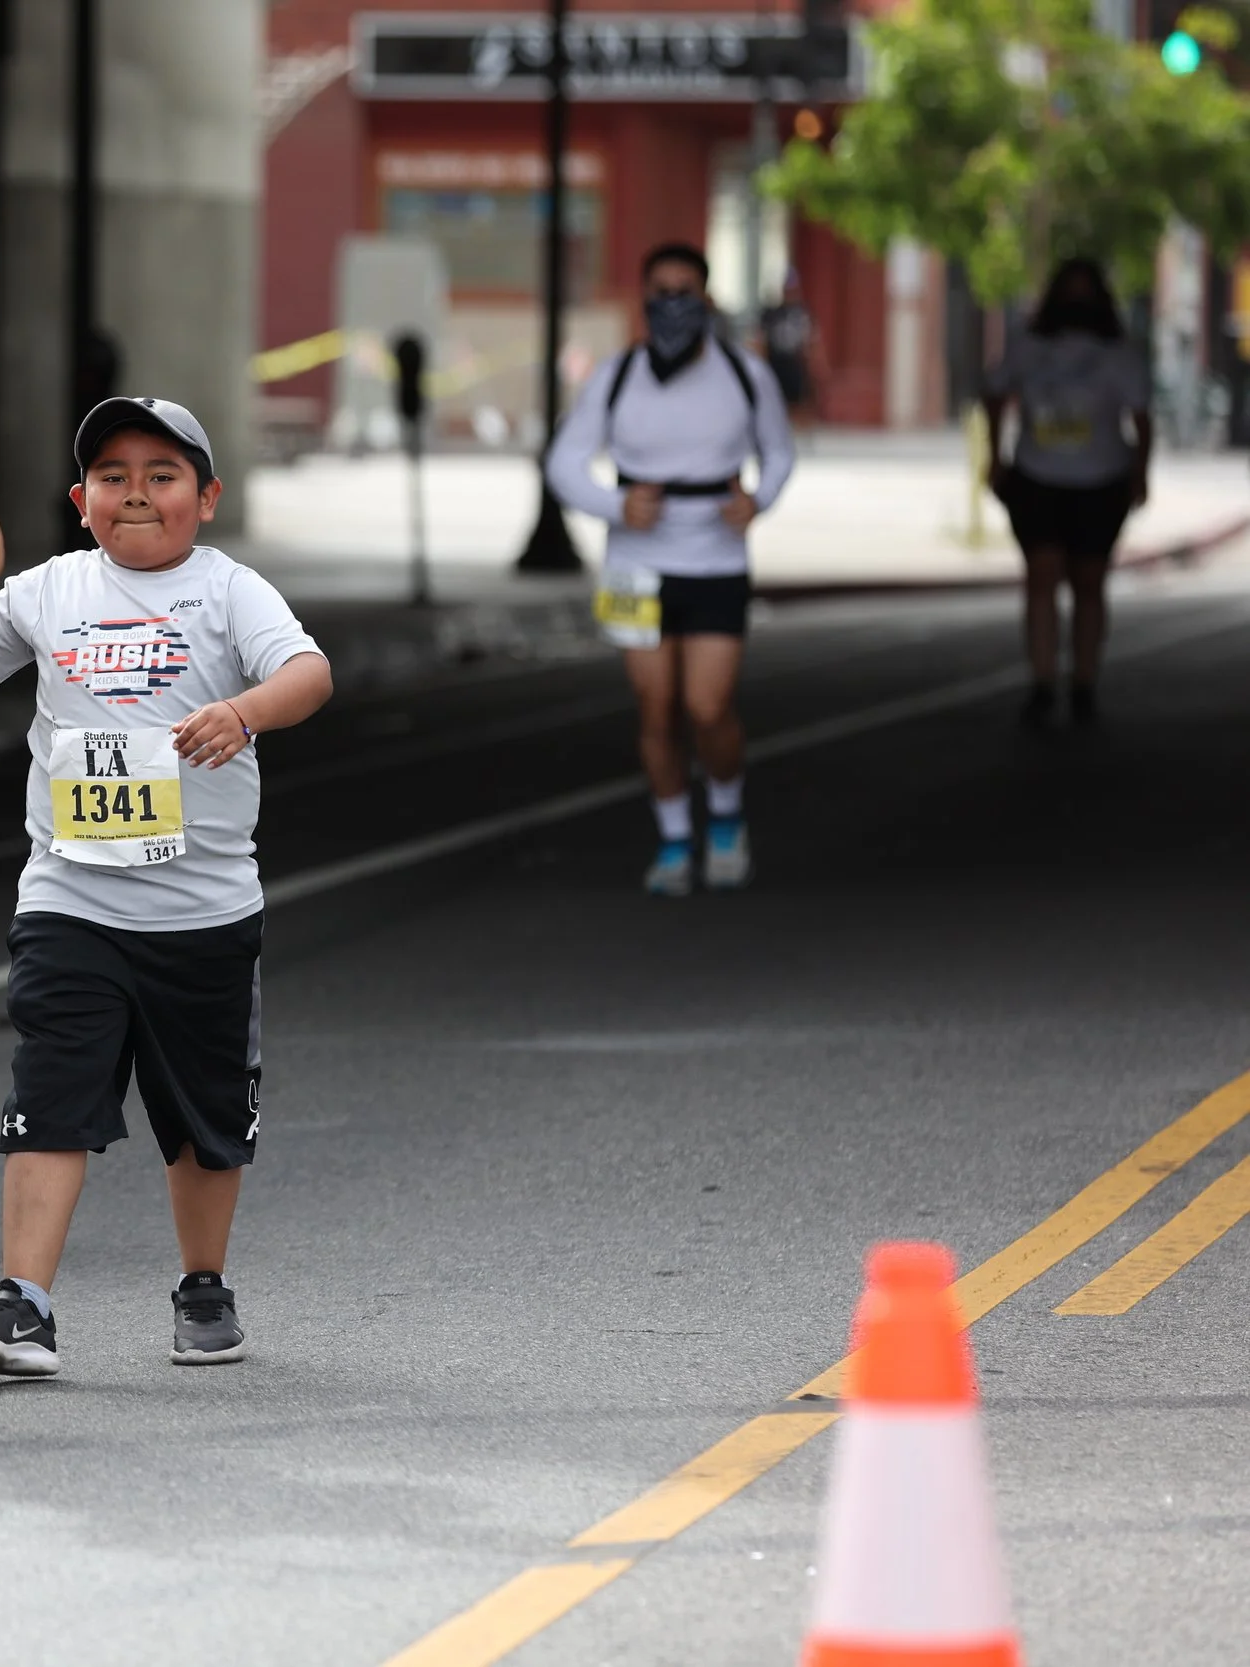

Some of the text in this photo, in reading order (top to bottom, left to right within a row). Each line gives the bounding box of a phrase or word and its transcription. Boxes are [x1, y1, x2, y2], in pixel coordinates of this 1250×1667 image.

[91, 630, 153, 641] ROSE BOWL
[75, 643, 168, 672] RUSH
[94, 675, 146, 685] KIDS RUN
[83, 731, 128, 741] Students
[84, 749, 130, 777] LA
[71, 784, 158, 823] 1341
[144, 845, 178, 862] 1341
